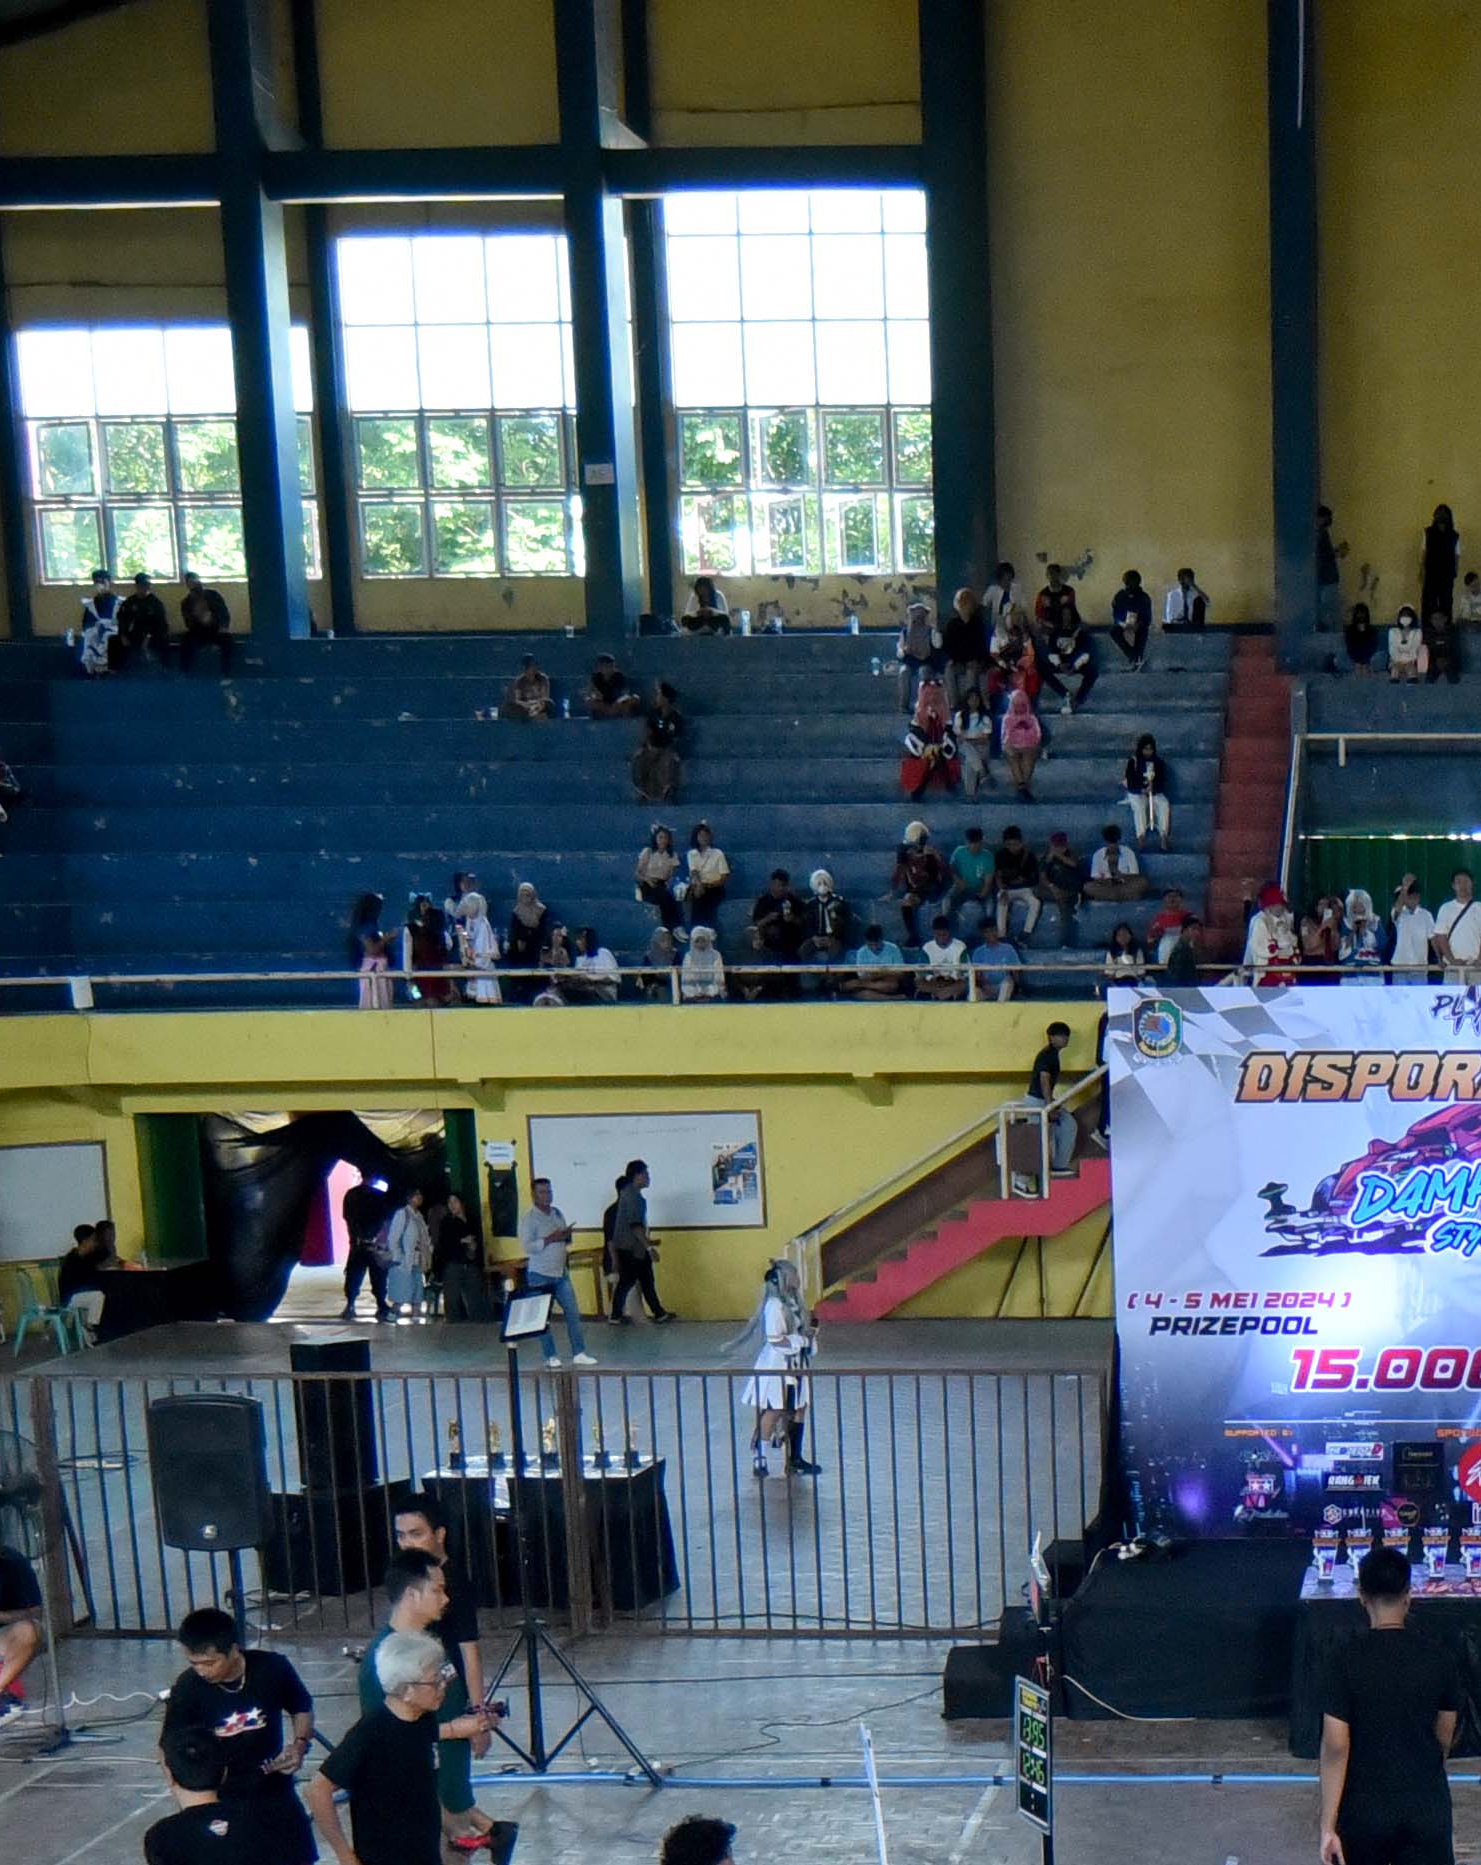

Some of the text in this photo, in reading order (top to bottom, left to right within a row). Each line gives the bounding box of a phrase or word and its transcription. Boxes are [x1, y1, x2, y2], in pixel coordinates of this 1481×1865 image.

[1145, 1293, 1162, 1309] 4
[1184, 1293, 1203, 1309] 5
[1210, 1293, 1258, 1309] MEI
[1264, 1292, 1336, 1308] 2024
[1149, 1316, 1318, 1336] PRIZEPOOL
